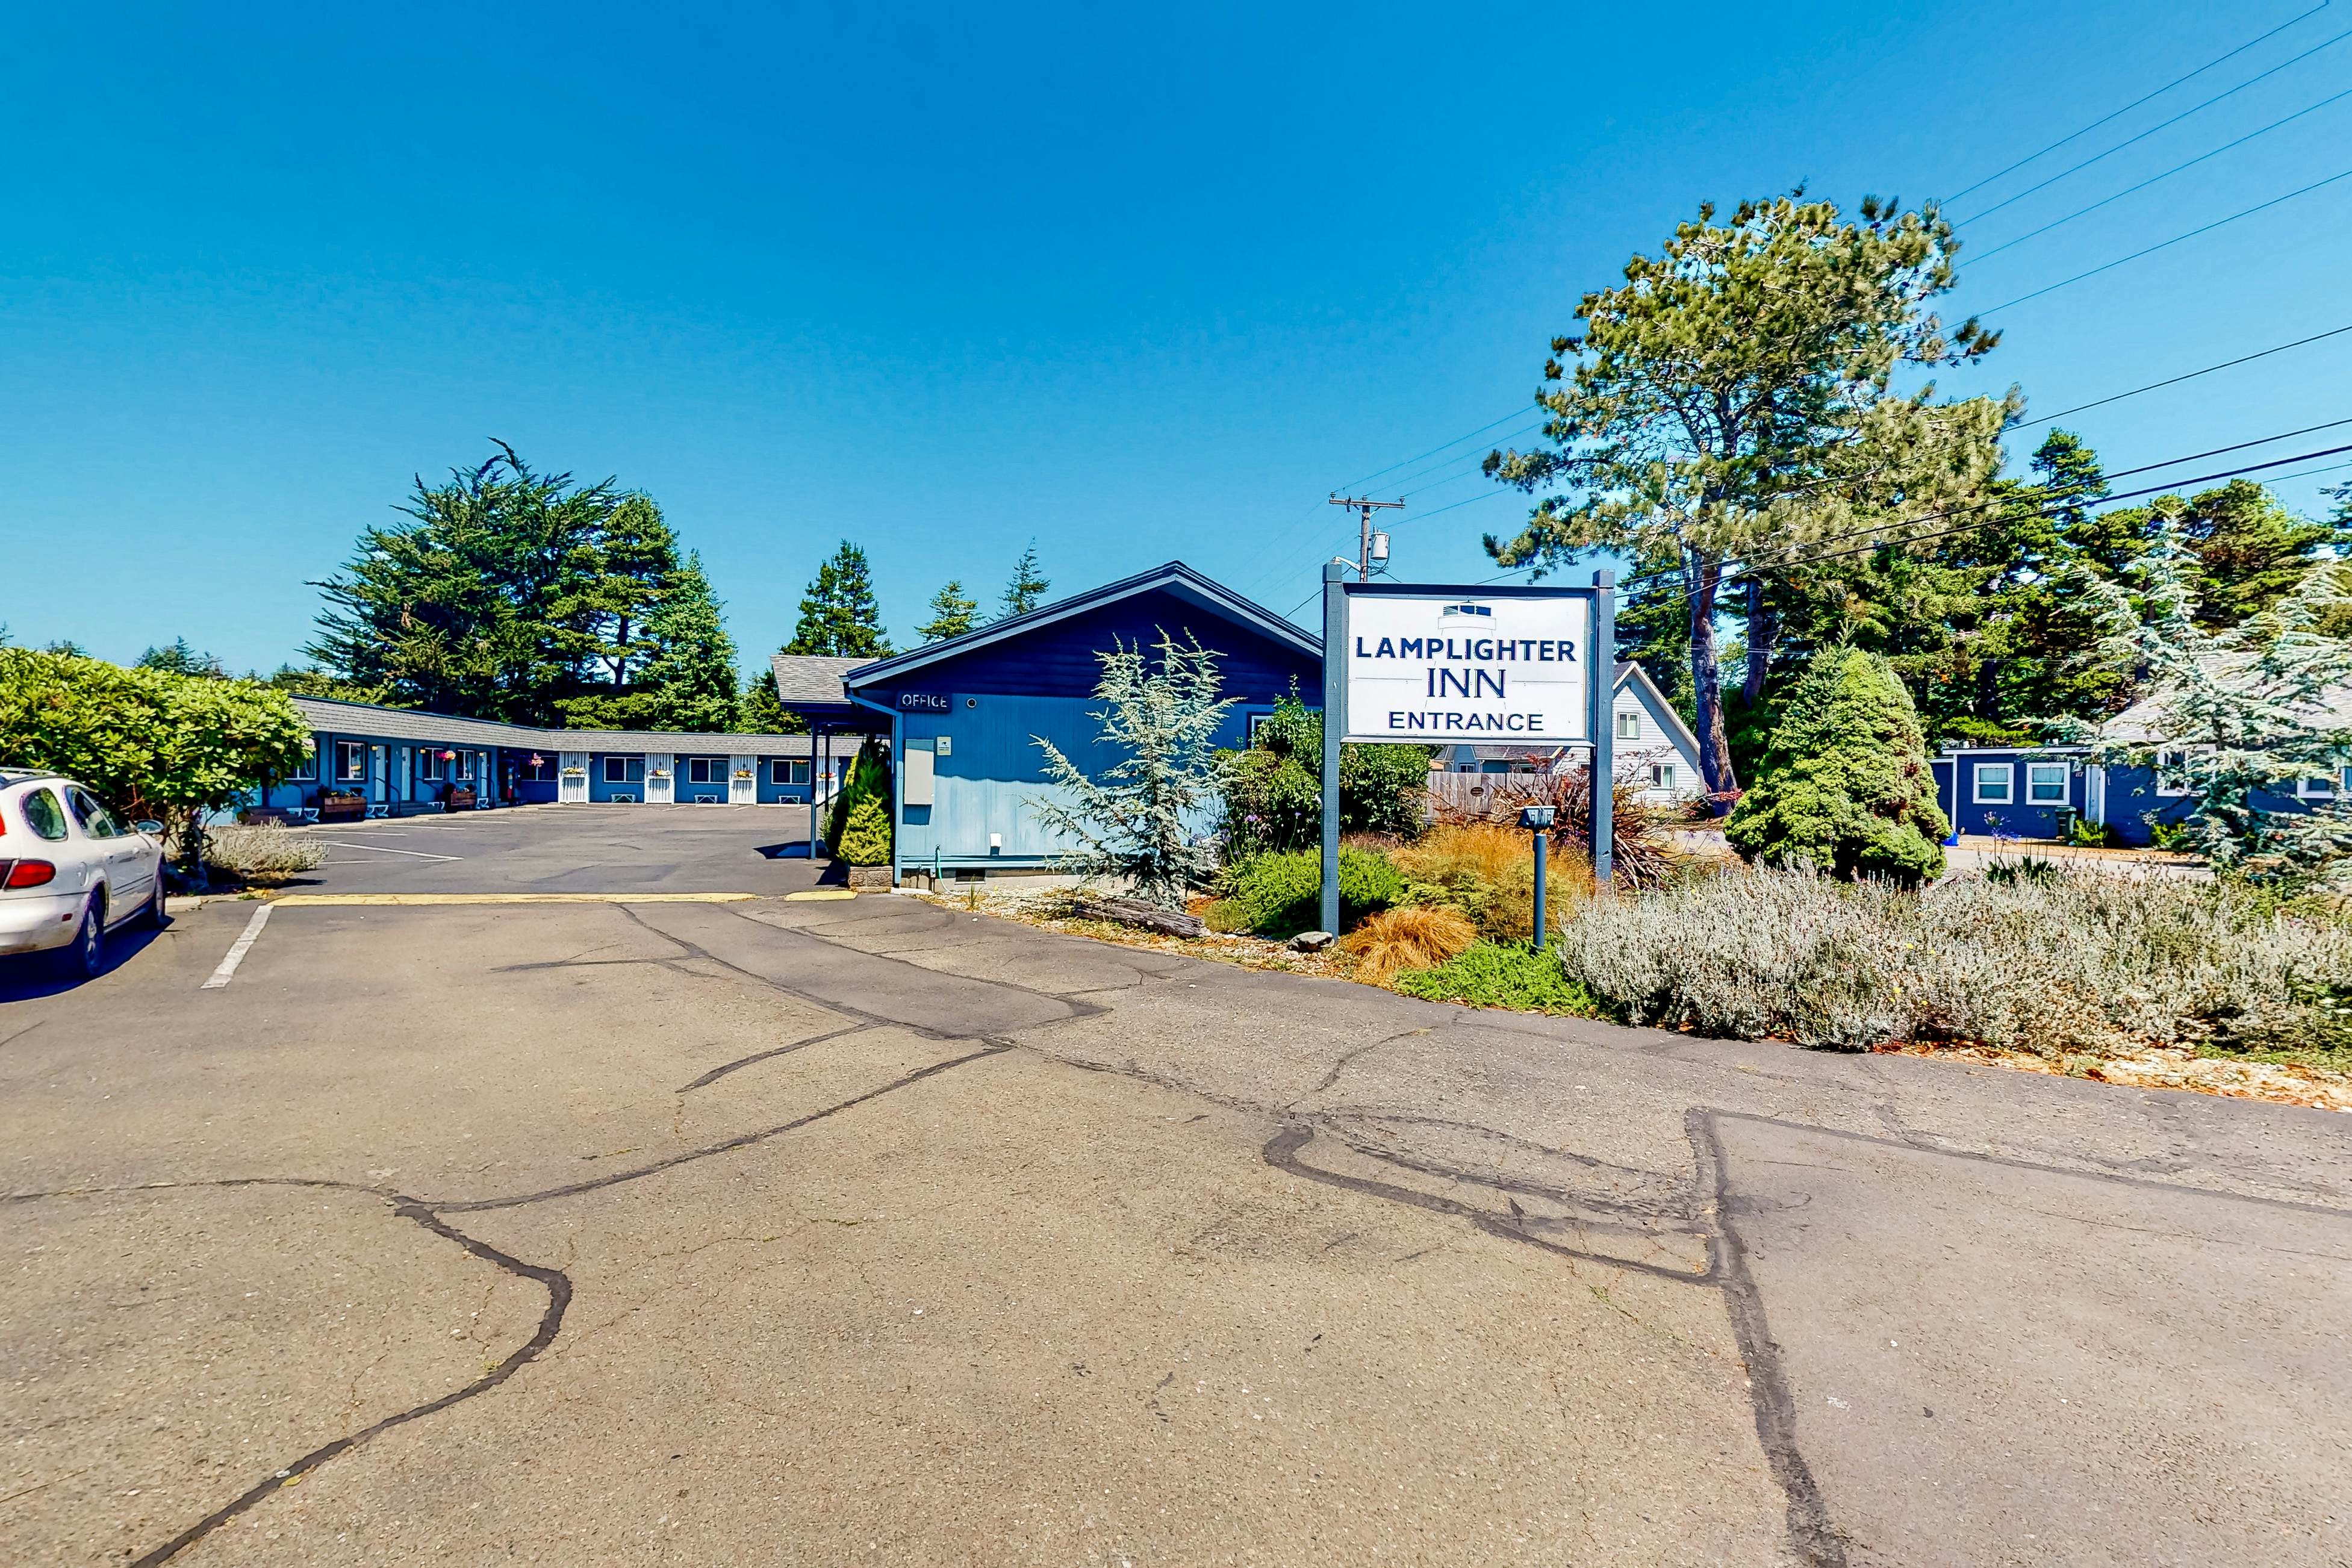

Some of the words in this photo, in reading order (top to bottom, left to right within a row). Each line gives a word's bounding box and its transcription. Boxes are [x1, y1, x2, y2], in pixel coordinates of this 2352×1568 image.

[1356, 636, 1576, 662] LAMPLIGHTER
[1426, 668, 1506, 698] INN
[902, 694, 947, 708] OFFICE
[1389, 711, 1544, 731] ENTRANCE
